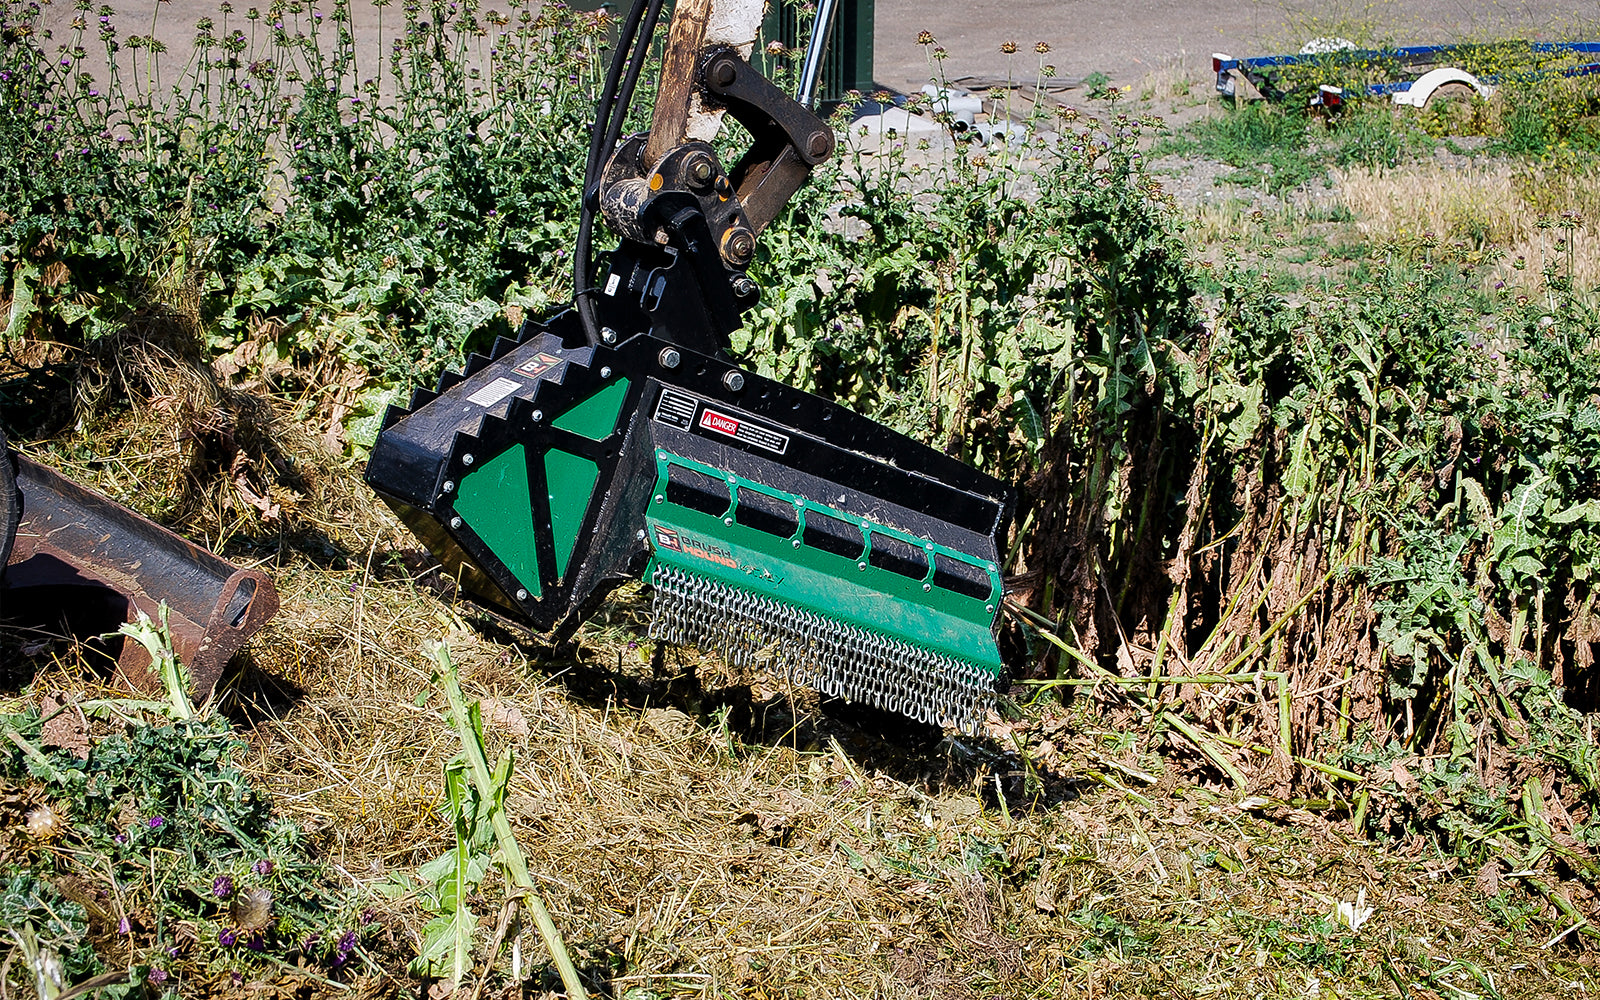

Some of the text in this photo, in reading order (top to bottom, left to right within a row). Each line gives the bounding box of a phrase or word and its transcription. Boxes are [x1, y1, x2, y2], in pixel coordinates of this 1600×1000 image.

[712, 417, 737, 433] DANGER
[681, 536, 731, 558] BRUSH
[682, 544, 738, 569] HOUND
